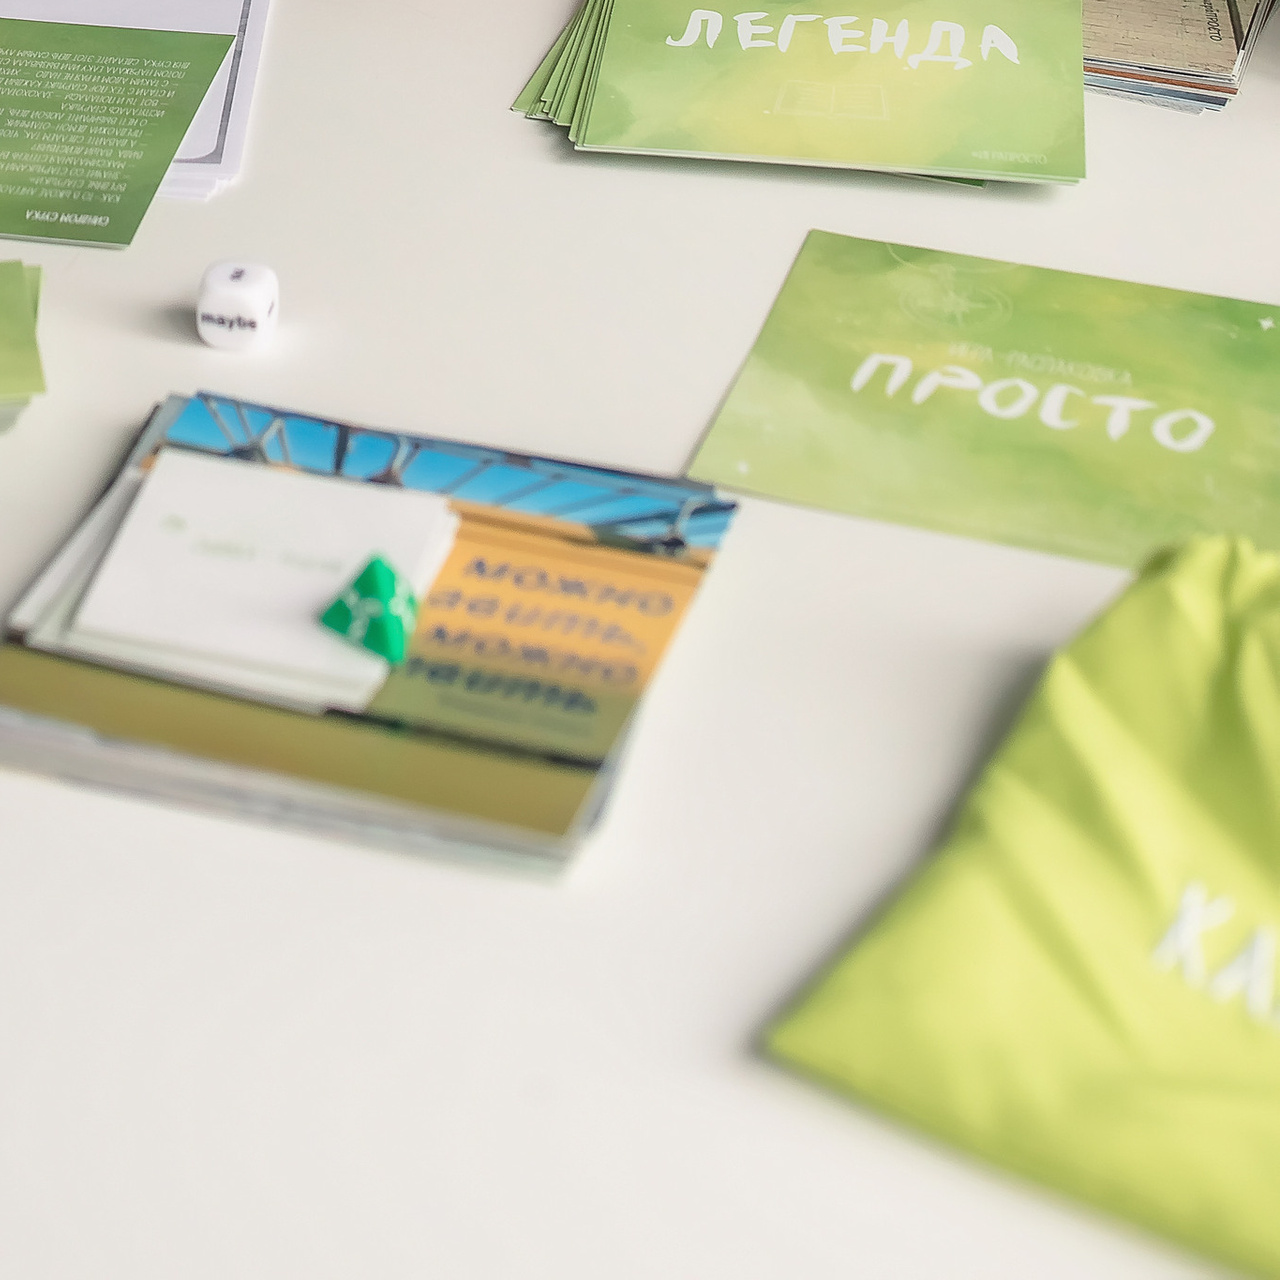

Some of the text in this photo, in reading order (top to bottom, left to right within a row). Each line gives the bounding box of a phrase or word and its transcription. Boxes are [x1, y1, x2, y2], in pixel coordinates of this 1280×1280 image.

[665, 9, 1020, 70] ЛЕГЕНДА
[49, 51, 72, 60] ДЕНЬ
[71, 53, 95, 62] ЭТОТ
[73, 72, 92, 81] РАЯ
[100, 74, 128, 85] АДОМ
[152, 69, 186, 80] ПОТОМ
[128, 77, 159, 87] ТАКИМ
[88, 83, 109, 93] ПОР
[108, 85, 126, 94] ТЕХ
[134, 87, 167, 98] СТАЛИ
[139, 97, 159, 107] ВОТ
[201, 311, 258, 332] maybe
[850, 353, 1216, 452] ПРОСТО
[1151, 880, 1279, 1030] КА
